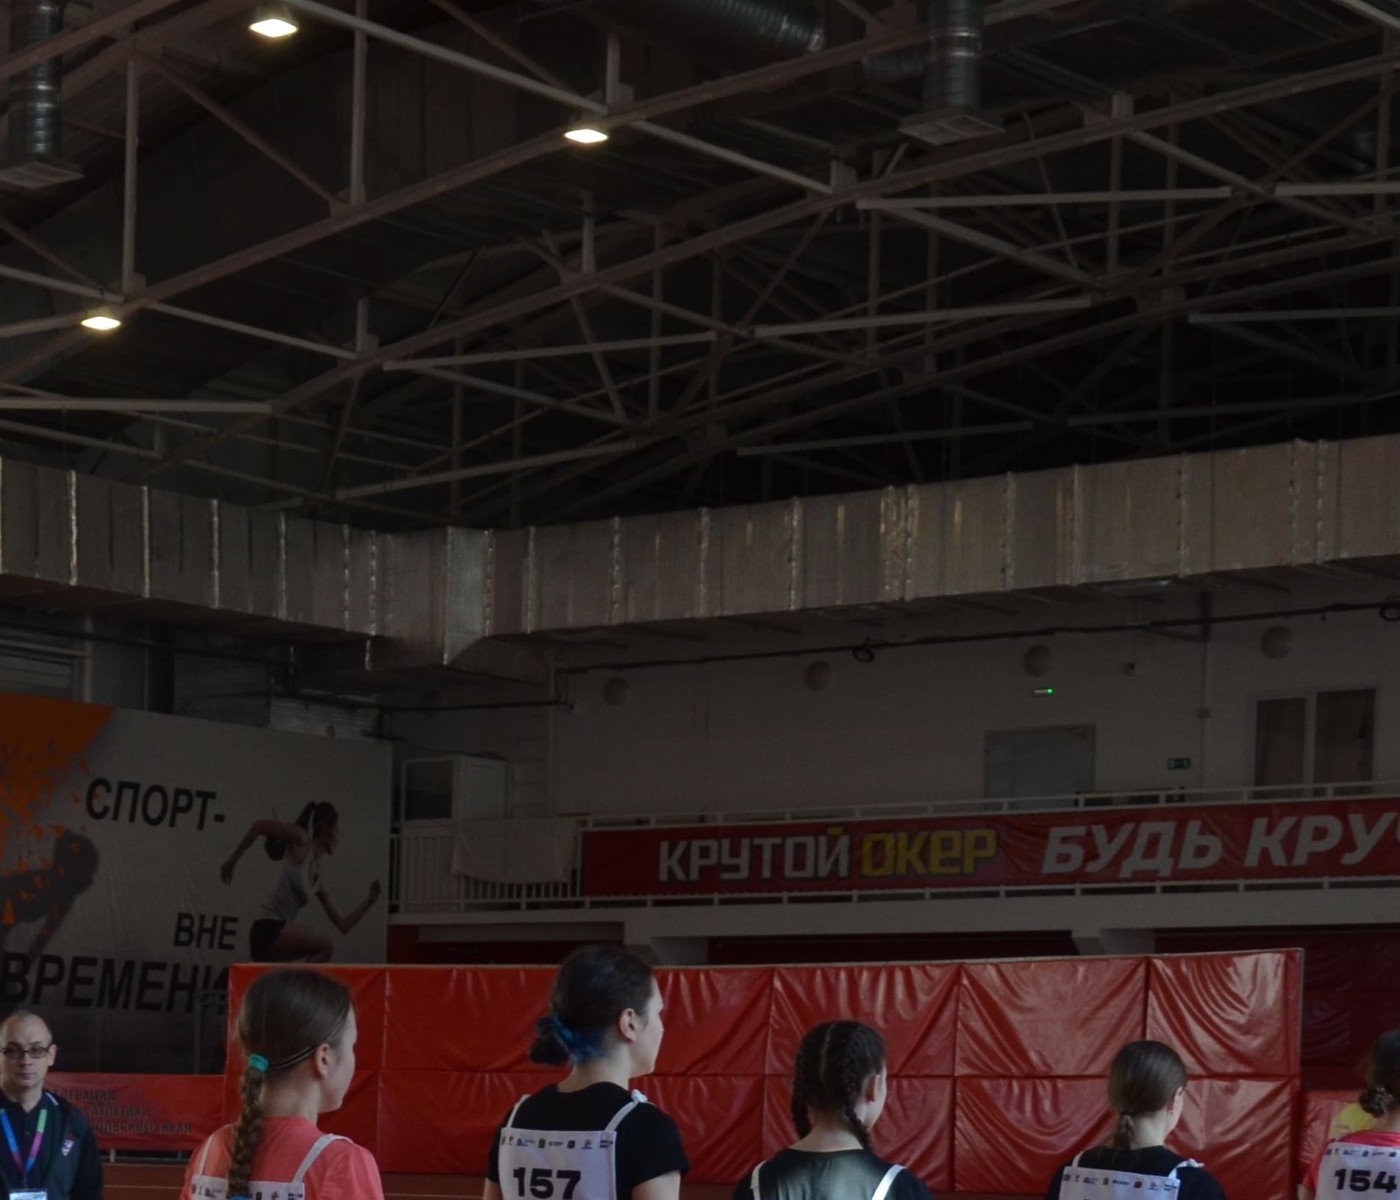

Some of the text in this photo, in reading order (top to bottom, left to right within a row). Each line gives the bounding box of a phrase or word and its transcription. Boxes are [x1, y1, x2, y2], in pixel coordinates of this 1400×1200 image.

[86, 777, 225, 831] СПОРТ-
[657, 826, 851, 882] КРУТОЙ
[1040, 810, 1400, 878] БУДЬ КРУ
[173, 911, 239, 951] ВНЕ
[513, 1166, 581, 1200] 157
[1334, 1168, 1397, 1194] 154
